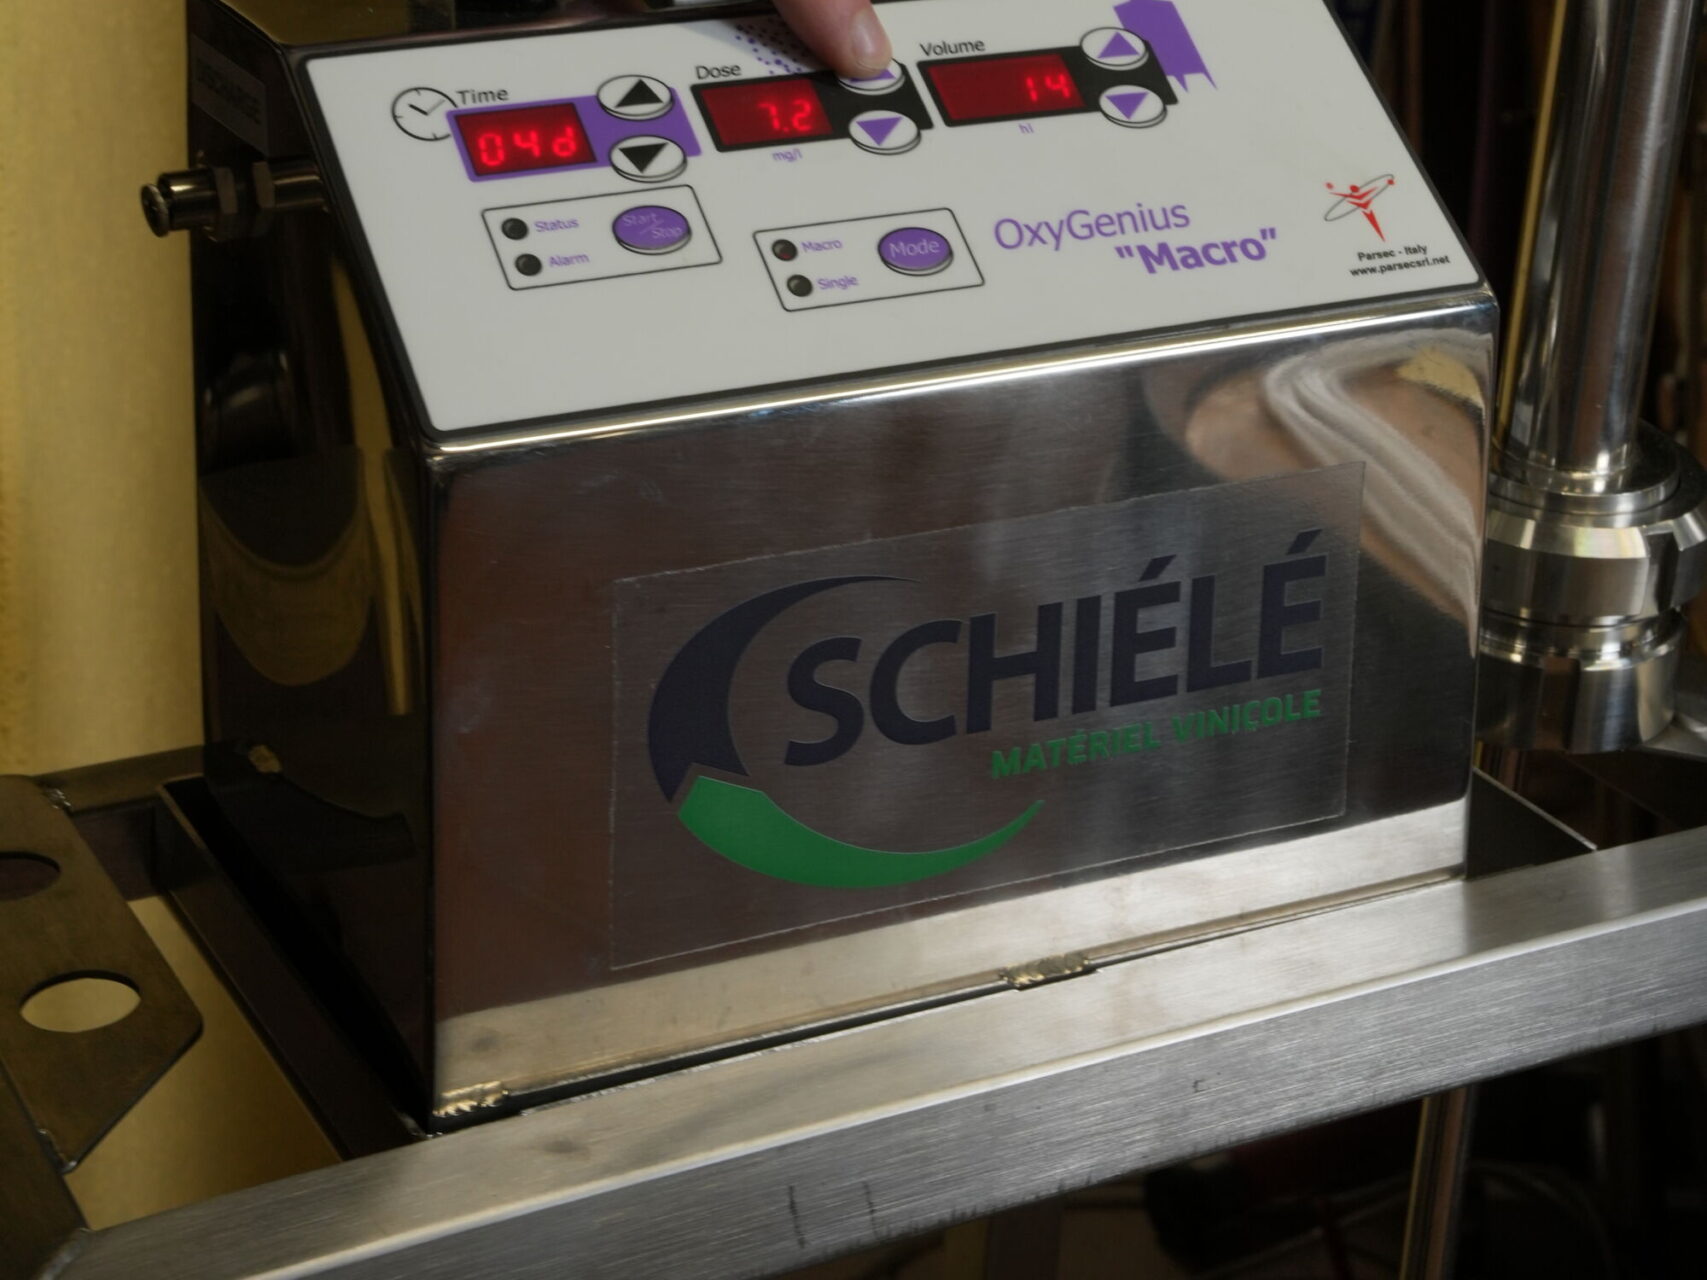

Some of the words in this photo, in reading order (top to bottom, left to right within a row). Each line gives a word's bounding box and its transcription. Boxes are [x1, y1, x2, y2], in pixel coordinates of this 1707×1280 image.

[919, 39, 986, 57] Volume
[695, 63, 742, 80] Dose
[456, 88, 510, 106] Time
[1025, 73, 1071, 103] 14
[757, 99, 812, 133] 7.2
[477, 125, 577, 167] 04d
[772, 148, 803, 163] mg/l
[534, 218, 580, 233] Status
[994, 202, 1190, 252] OxyGenius
[801, 239, 843, 252] Macro
[888, 238, 940, 258] Mode
[1114, 227, 1277, 274] "Macro"
[1357, 249, 1396, 262] Parsec
[1404, 245, 1428, 256] Italy
[549, 253, 590, 268] Alarm
[1350, 255, 1450, 277] www.parsecsrl.net
[817, 275, 859, 291] Single
[784, 529, 1328, 767] SCHIÉLÉ
[990, 720, 1162, 780] MATÉRIEL
[1171, 688, 1323, 743] VINICOLE
